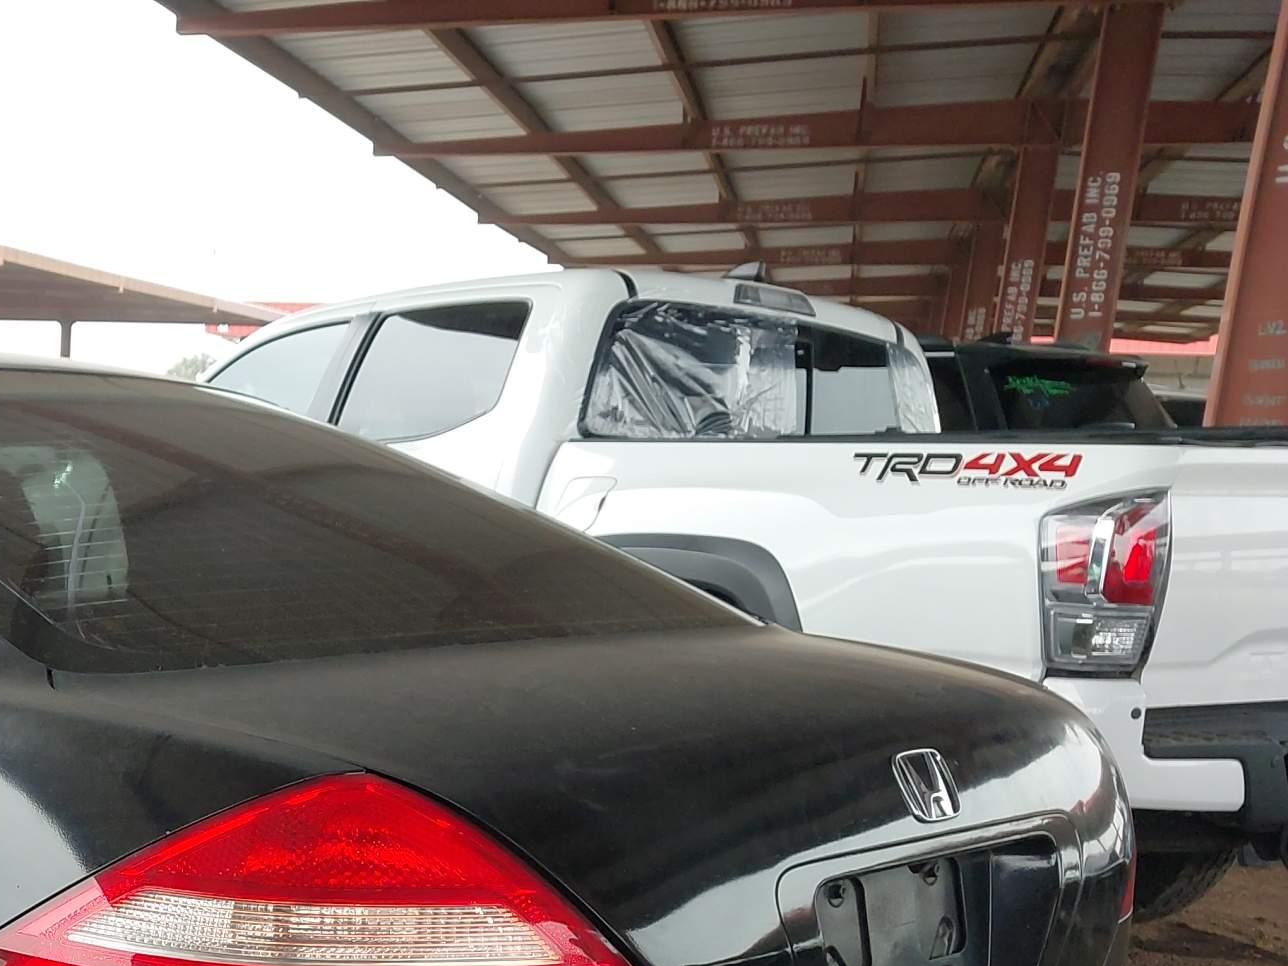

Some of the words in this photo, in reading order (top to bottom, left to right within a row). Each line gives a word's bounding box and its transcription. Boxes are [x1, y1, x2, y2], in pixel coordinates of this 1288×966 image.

[1075, 212, 1098, 278] PREFAB
[1070, 286, 1088, 319] U.S.
[853, 452, 964, 484] TRD
[962, 452, 1084, 478] 4X4
[956, 476, 1001, 488] OFF
[1002, 476, 1068, 490] ROAD
